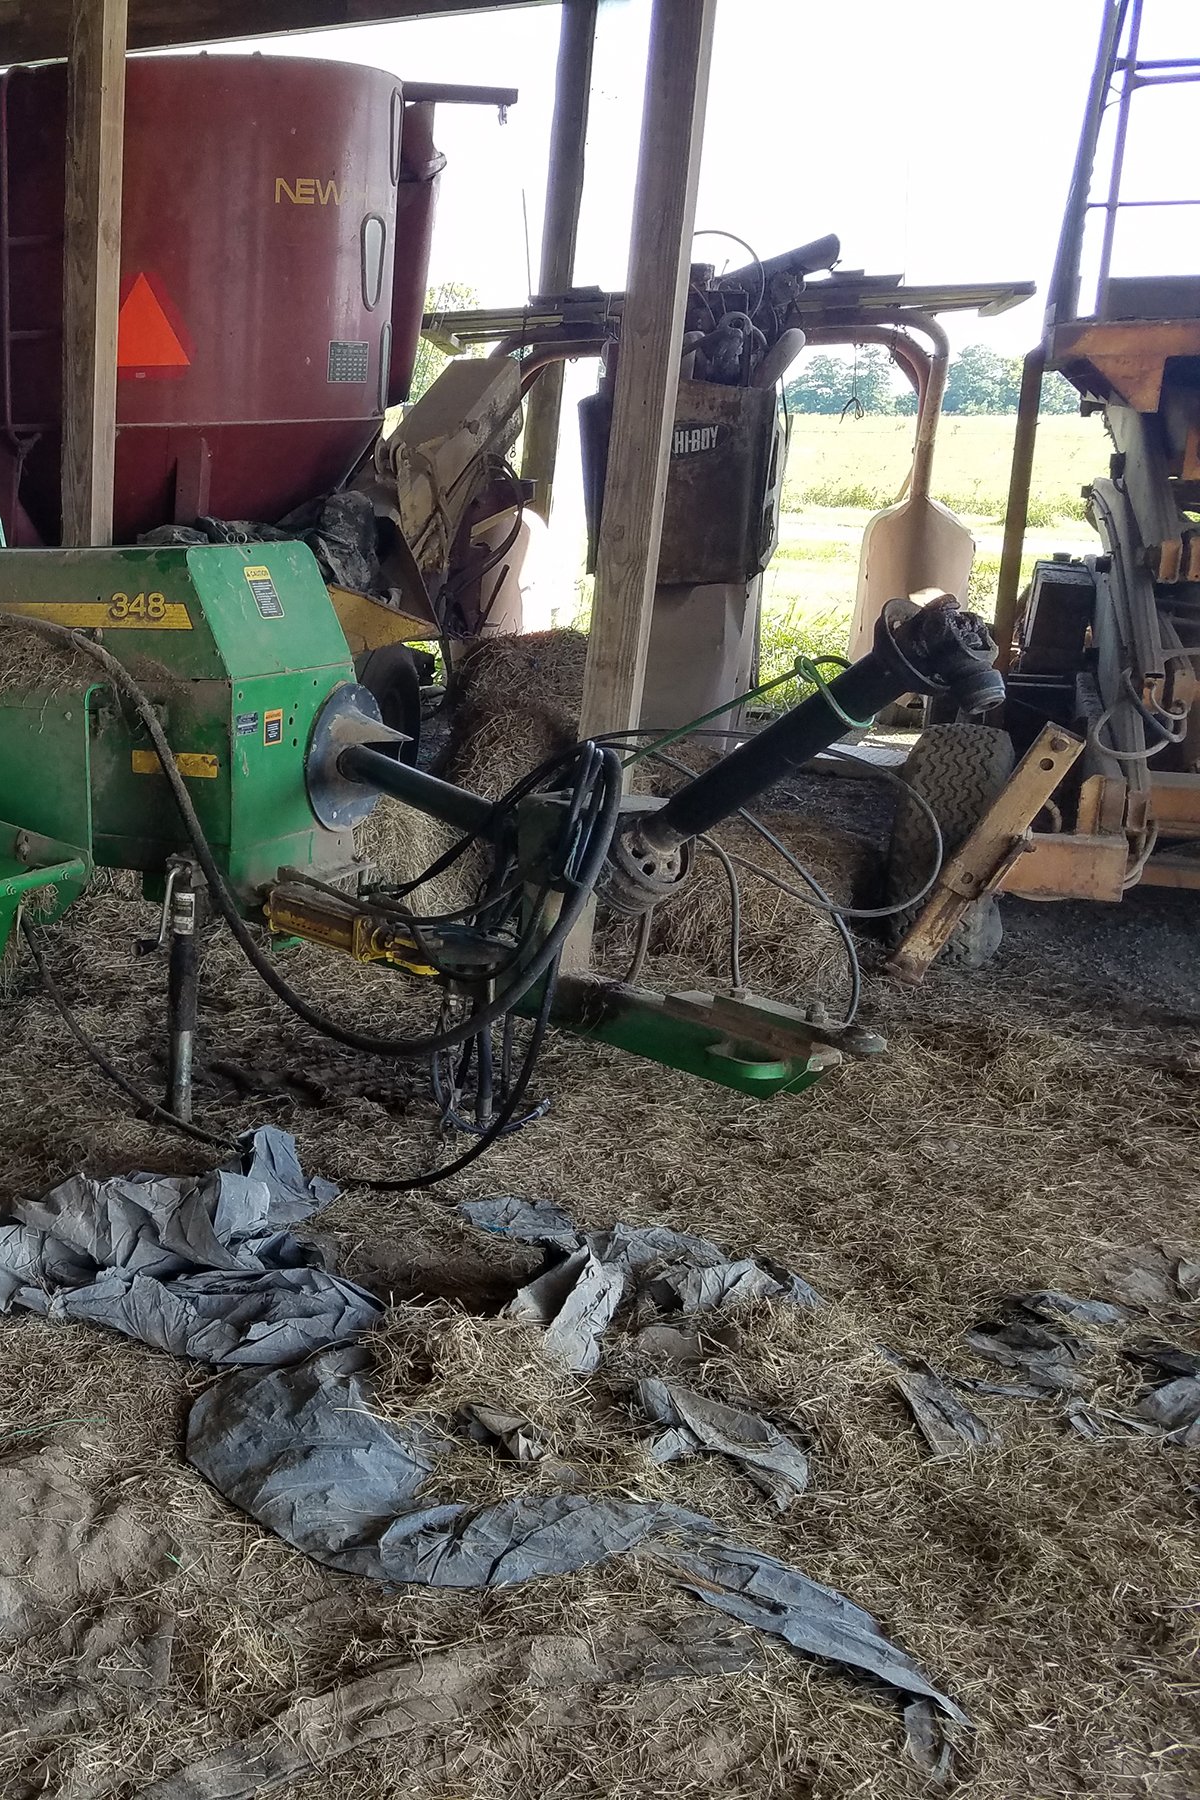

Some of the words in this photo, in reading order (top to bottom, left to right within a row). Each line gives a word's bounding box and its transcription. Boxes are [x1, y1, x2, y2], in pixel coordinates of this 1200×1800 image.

[275, 177, 346, 205] NEW
[674, 425, 719, 454] HI-BOY
[110, 591, 166, 619] 348
